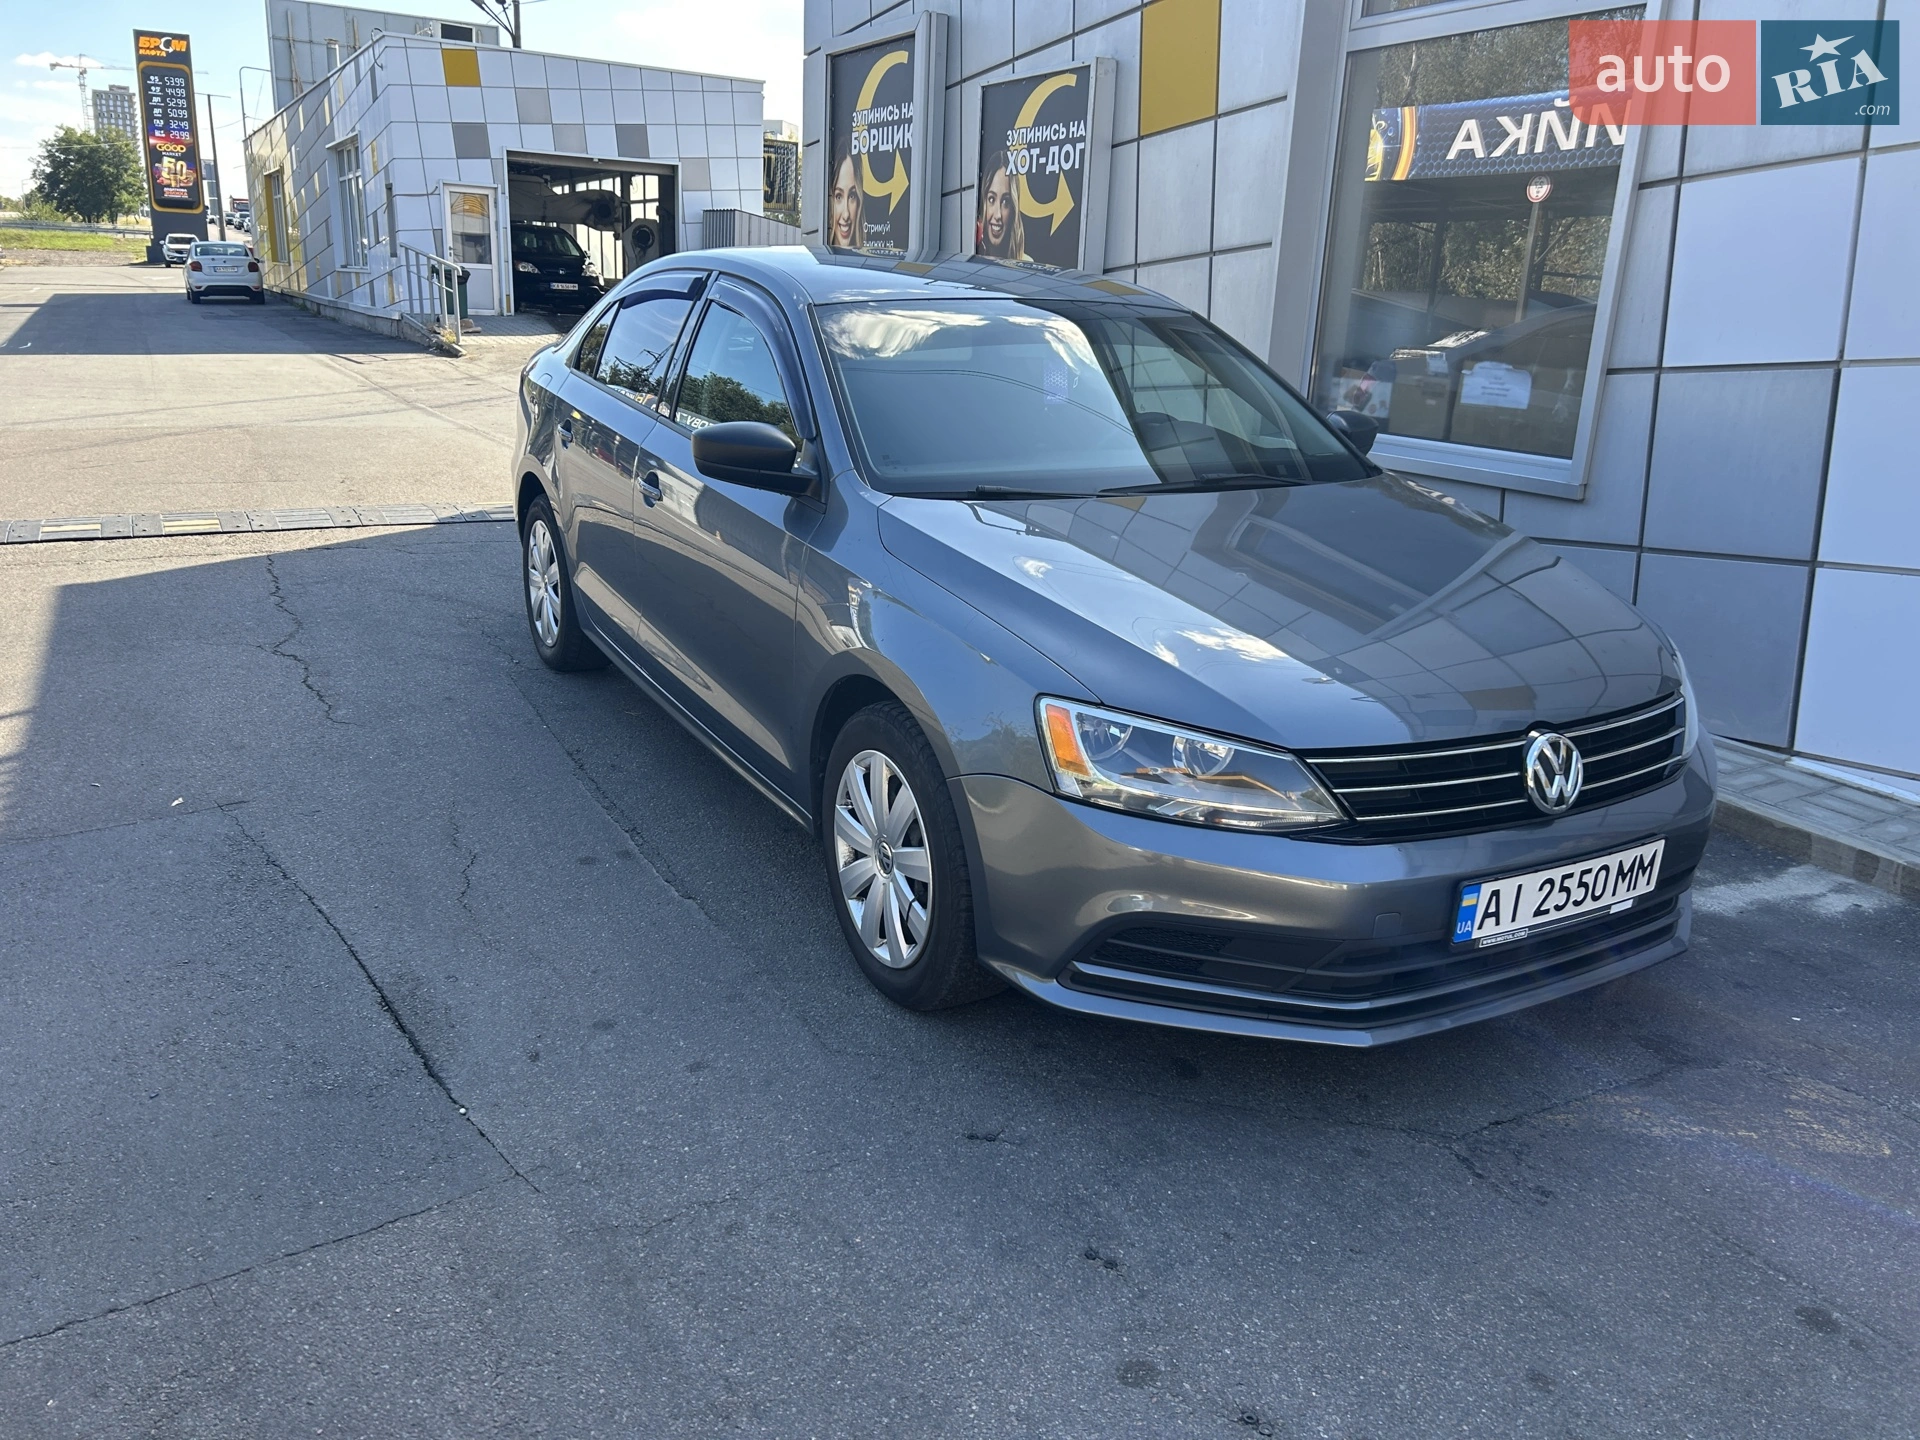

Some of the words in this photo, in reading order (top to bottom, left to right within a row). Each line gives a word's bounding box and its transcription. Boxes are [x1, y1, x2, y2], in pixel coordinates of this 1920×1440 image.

[852, 104, 900, 128] ЗУПИНИСЬ
[851, 122, 914, 155] БОРЩИК
[1006, 122, 1067, 147] ЗУПИНИСЬ
[1069, 119, 1086, 138] НА
[156, 143, 187, 153] GOOD
[1005, 142, 1085, 176] ХОТ-ДОГ
[863, 221, 890, 235] Отримуй
[1477, 883, 1523, 931] AI
[1532, 863, 1610, 918] 2550
[1611, 848, 1658, 897] MM
[1456, 920, 1472, 935] UA
